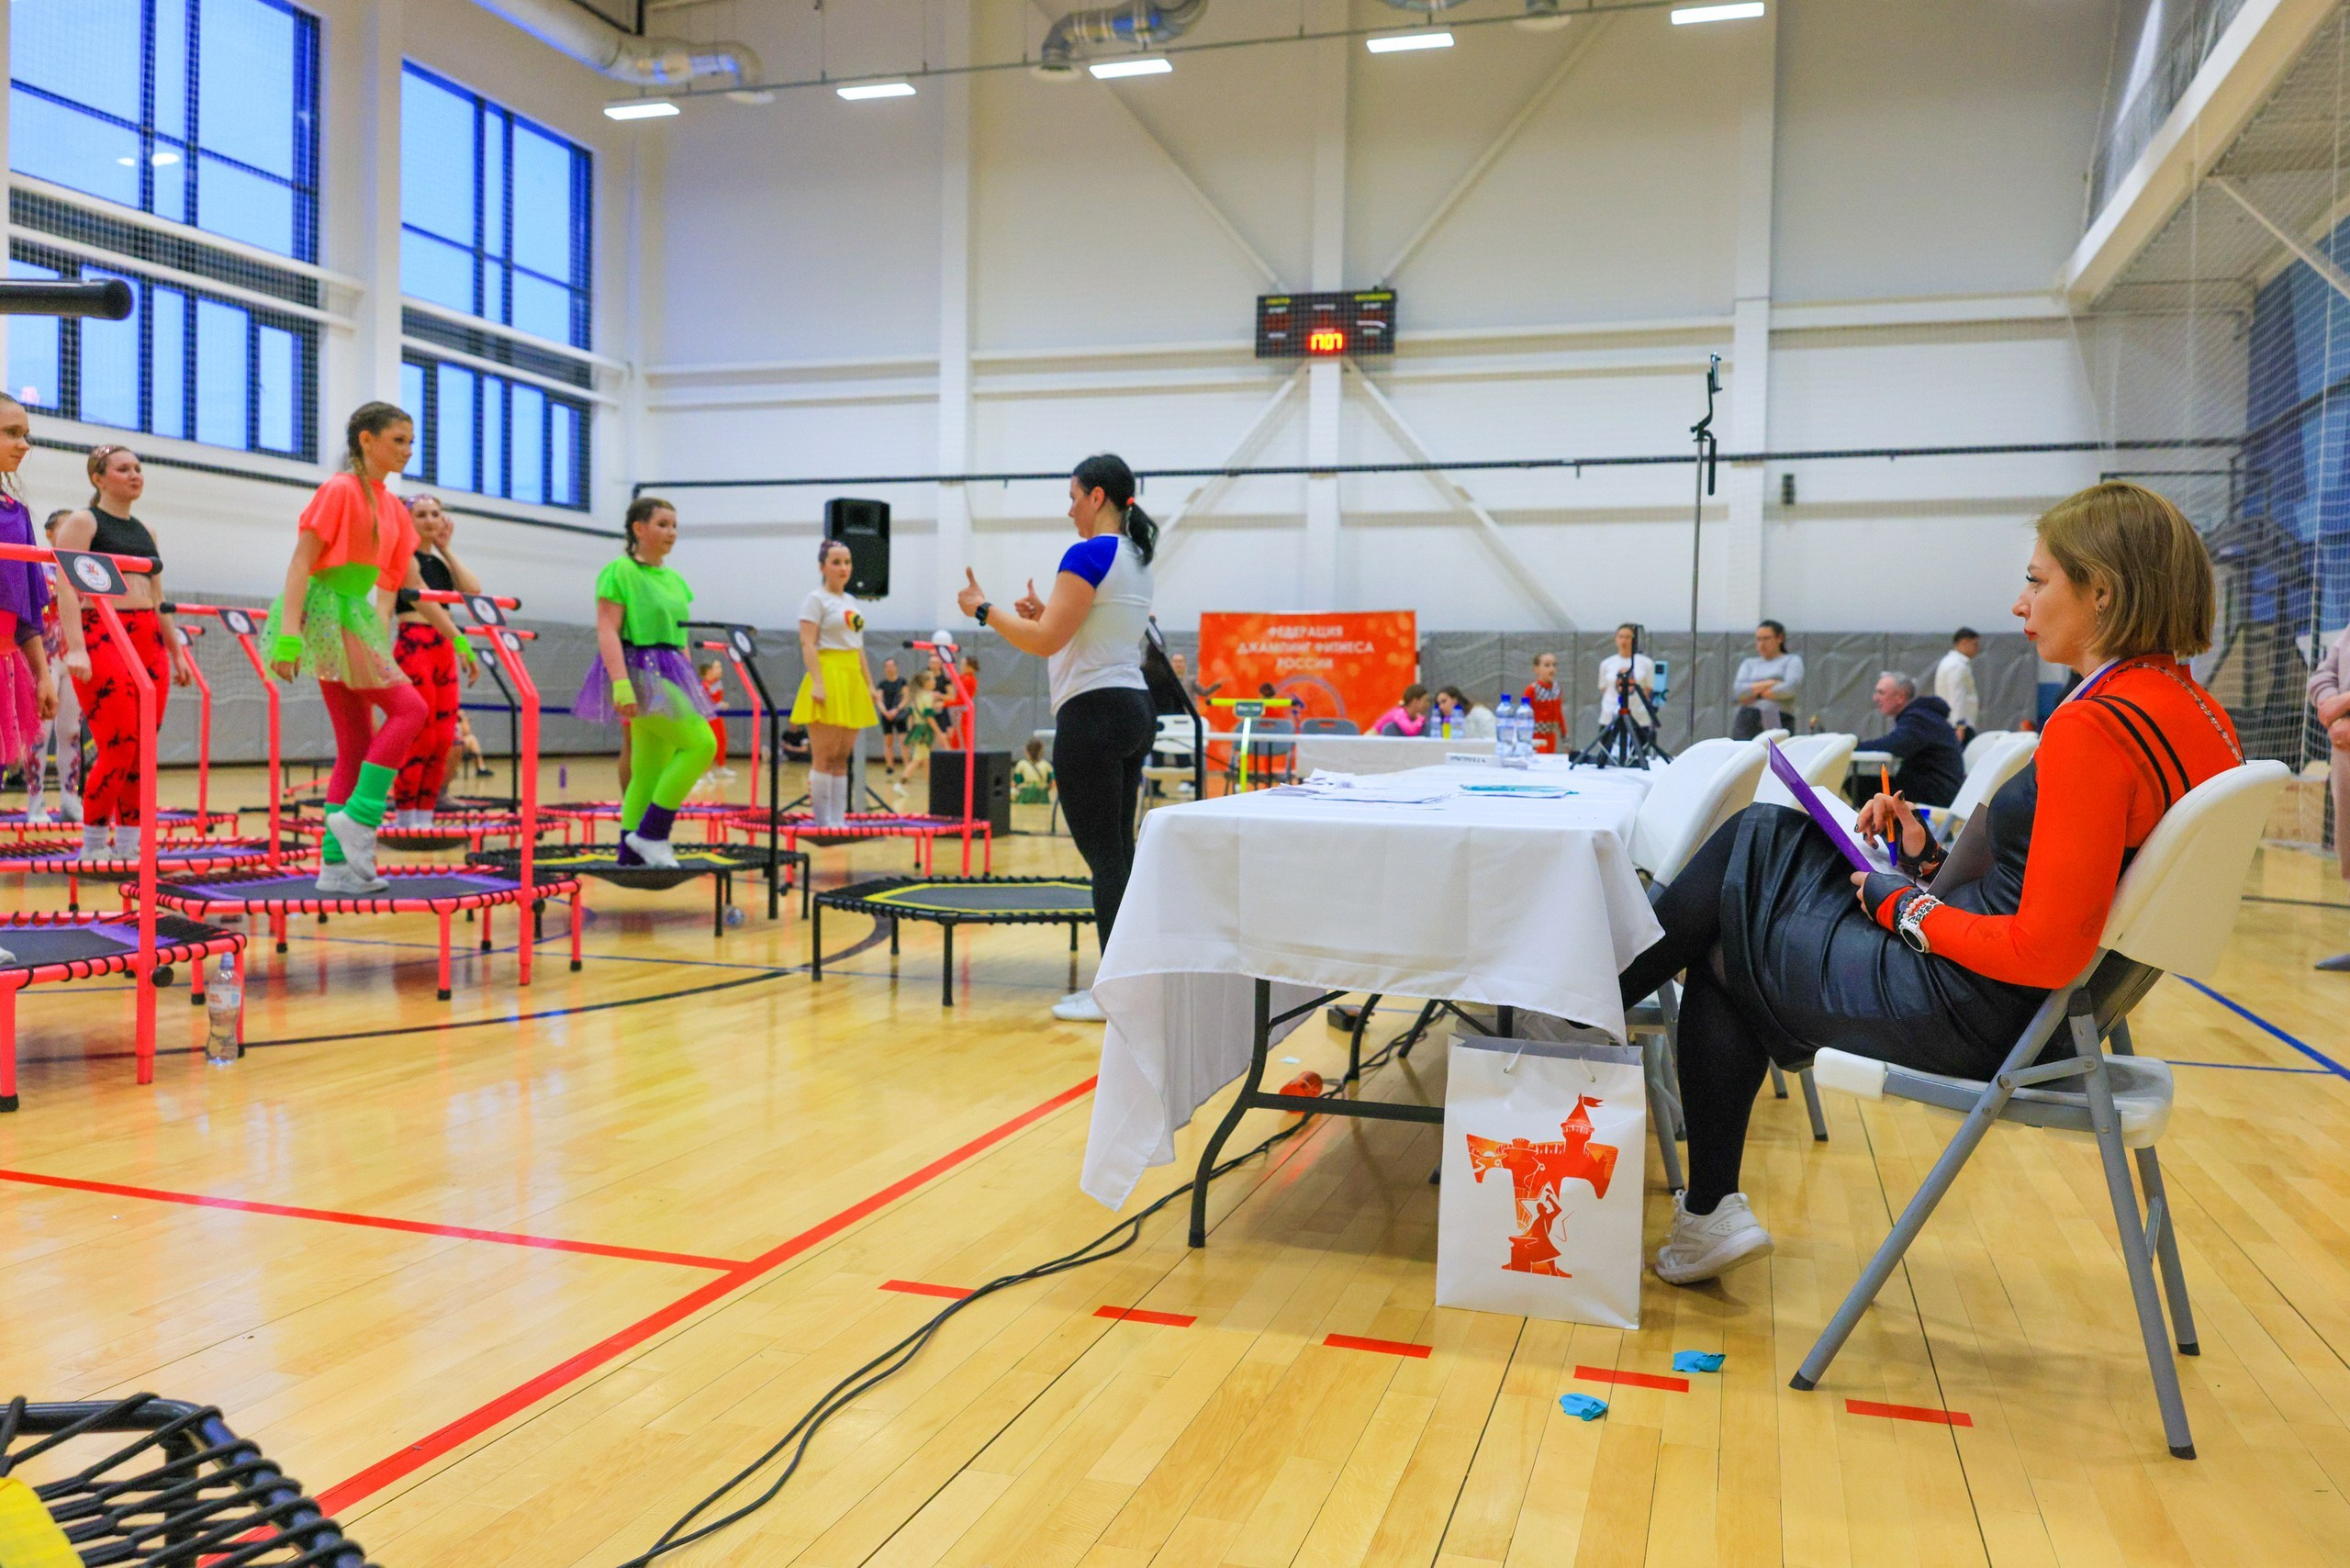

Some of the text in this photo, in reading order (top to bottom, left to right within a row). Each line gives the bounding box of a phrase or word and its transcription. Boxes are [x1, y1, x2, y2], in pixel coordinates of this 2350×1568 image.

[1268, 626, 1343, 639] ФЕДЕРАЦИЯ
[1237, 641, 1375, 655] ДЖАМПИНГ ФИТНЕСА
[1277, 657, 1334, 669] РОССИИ
